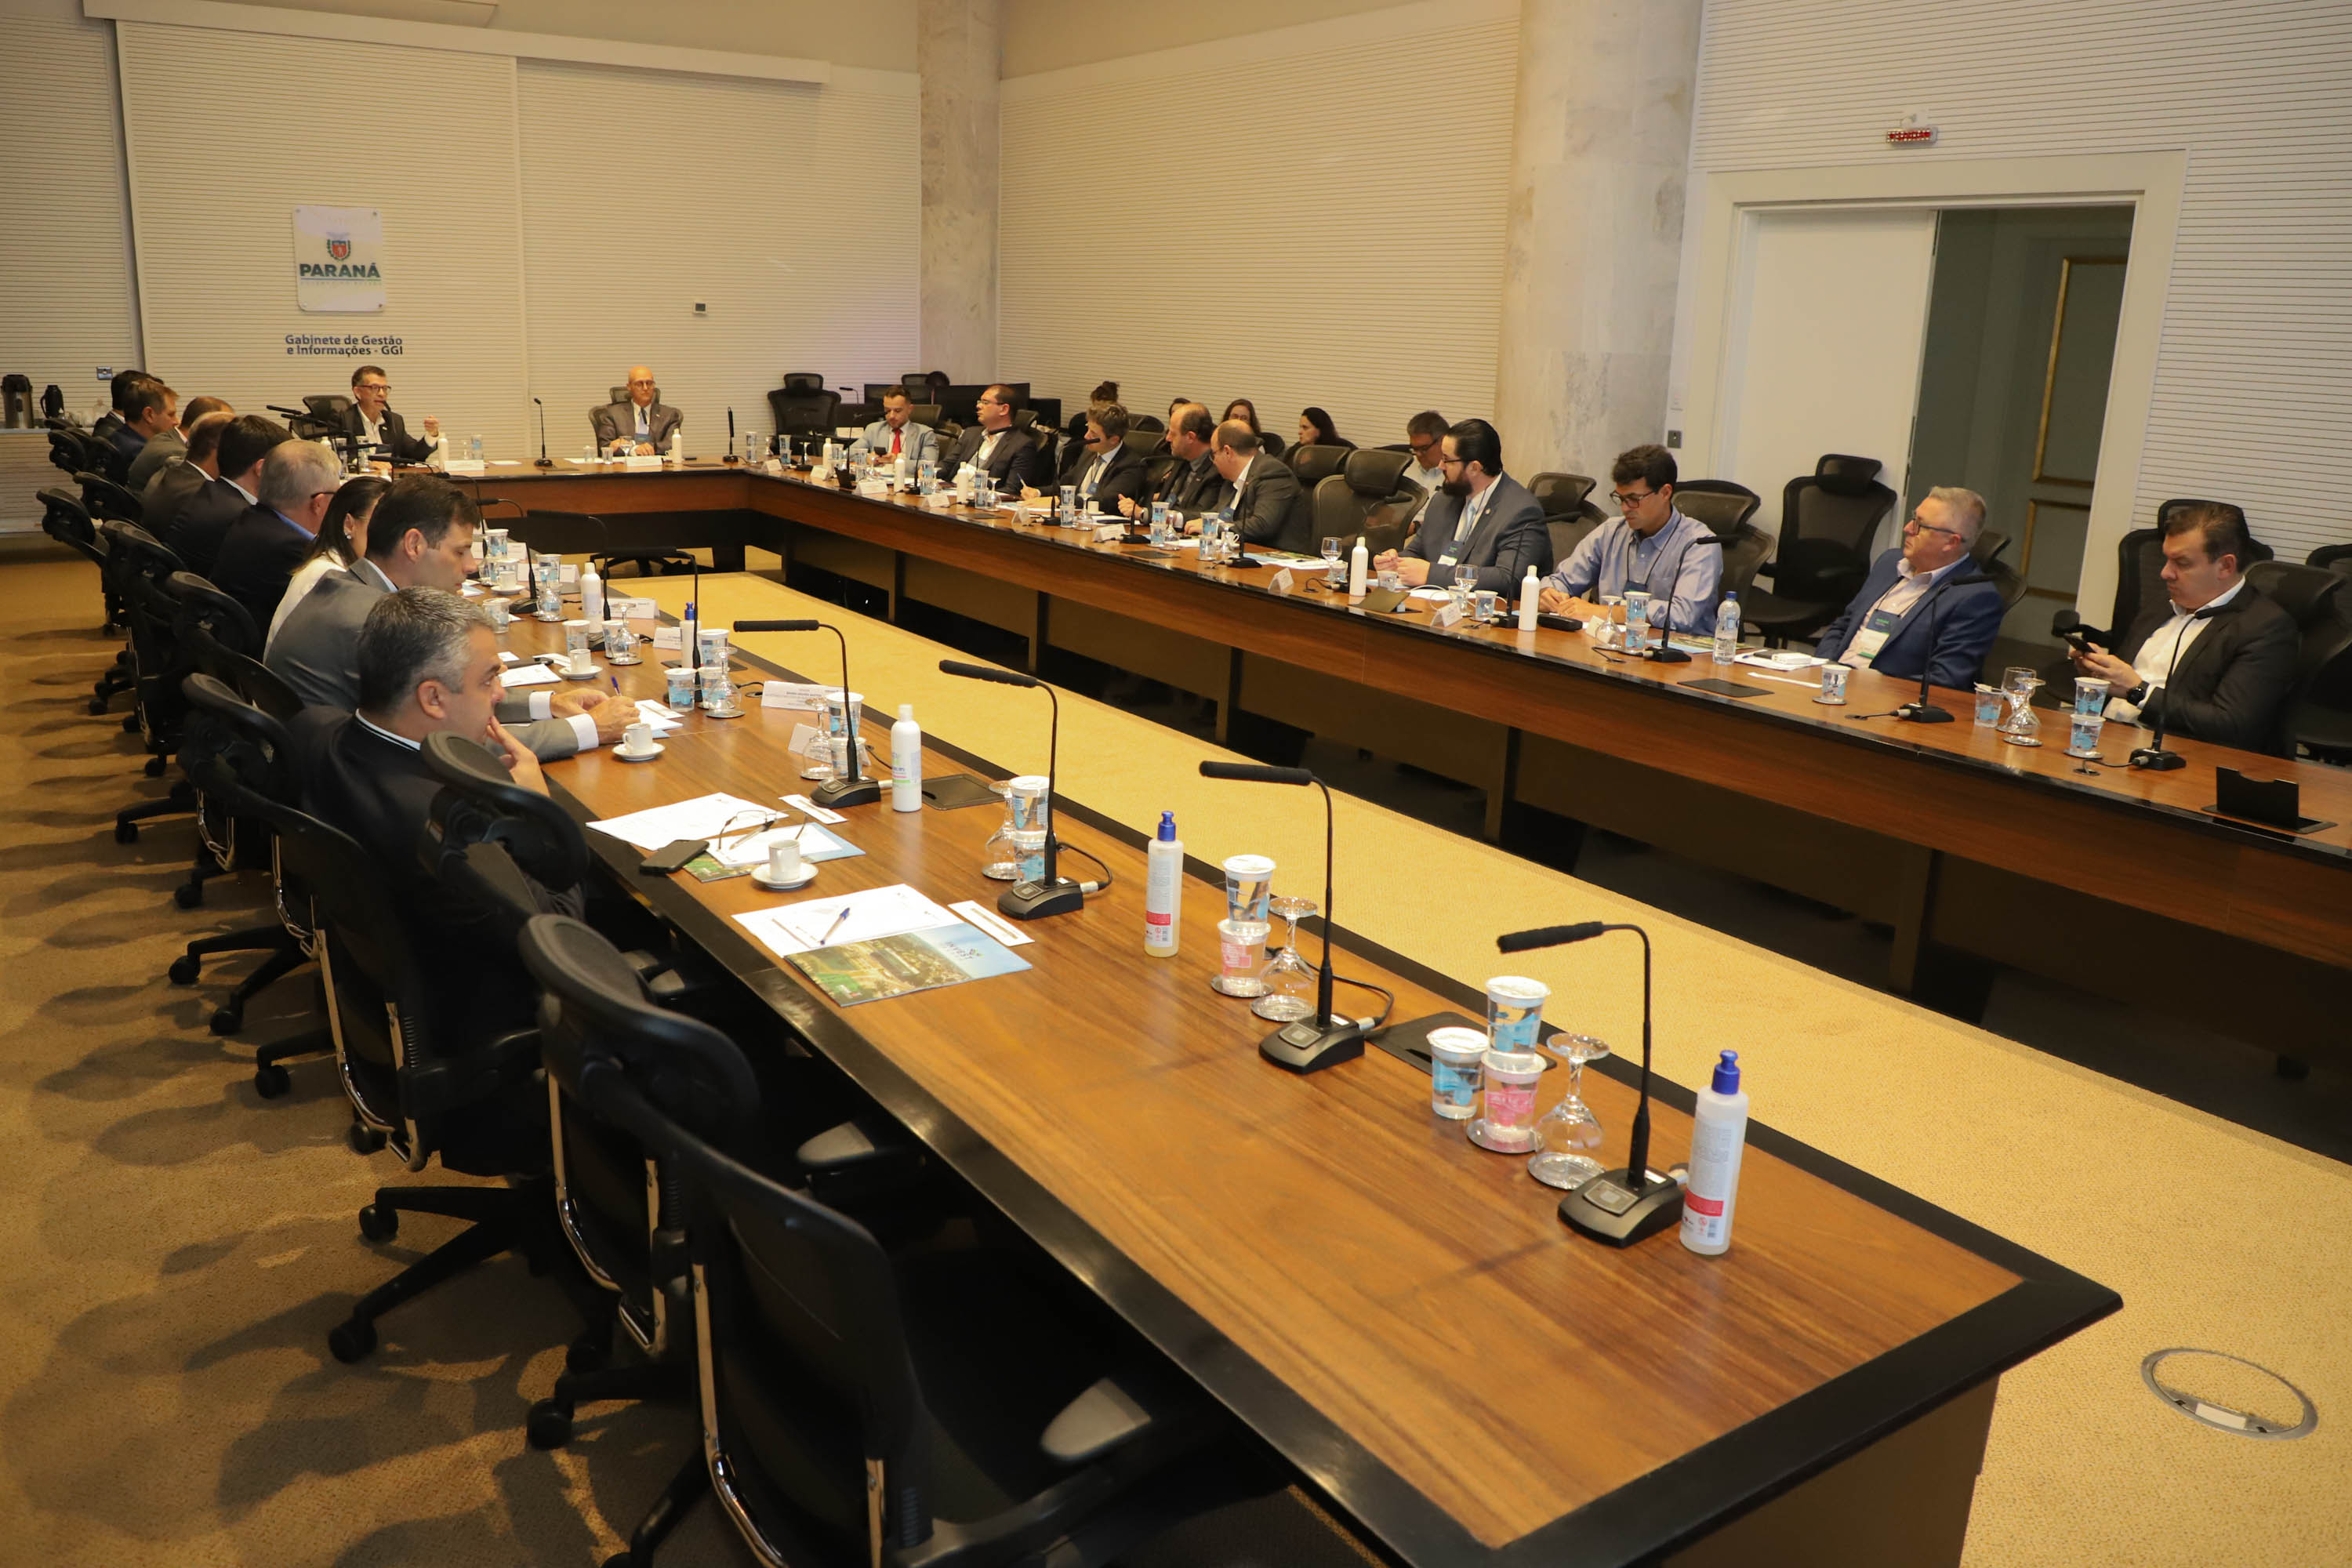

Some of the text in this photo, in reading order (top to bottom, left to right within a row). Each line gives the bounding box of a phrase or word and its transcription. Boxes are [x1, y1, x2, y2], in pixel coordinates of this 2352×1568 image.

[299, 263, 380, 278] PARANÁ
[285, 334, 403, 345] Gabinete de Gestão
[297, 345, 372, 357] Informações
[381, 346, 403, 355] GGI
